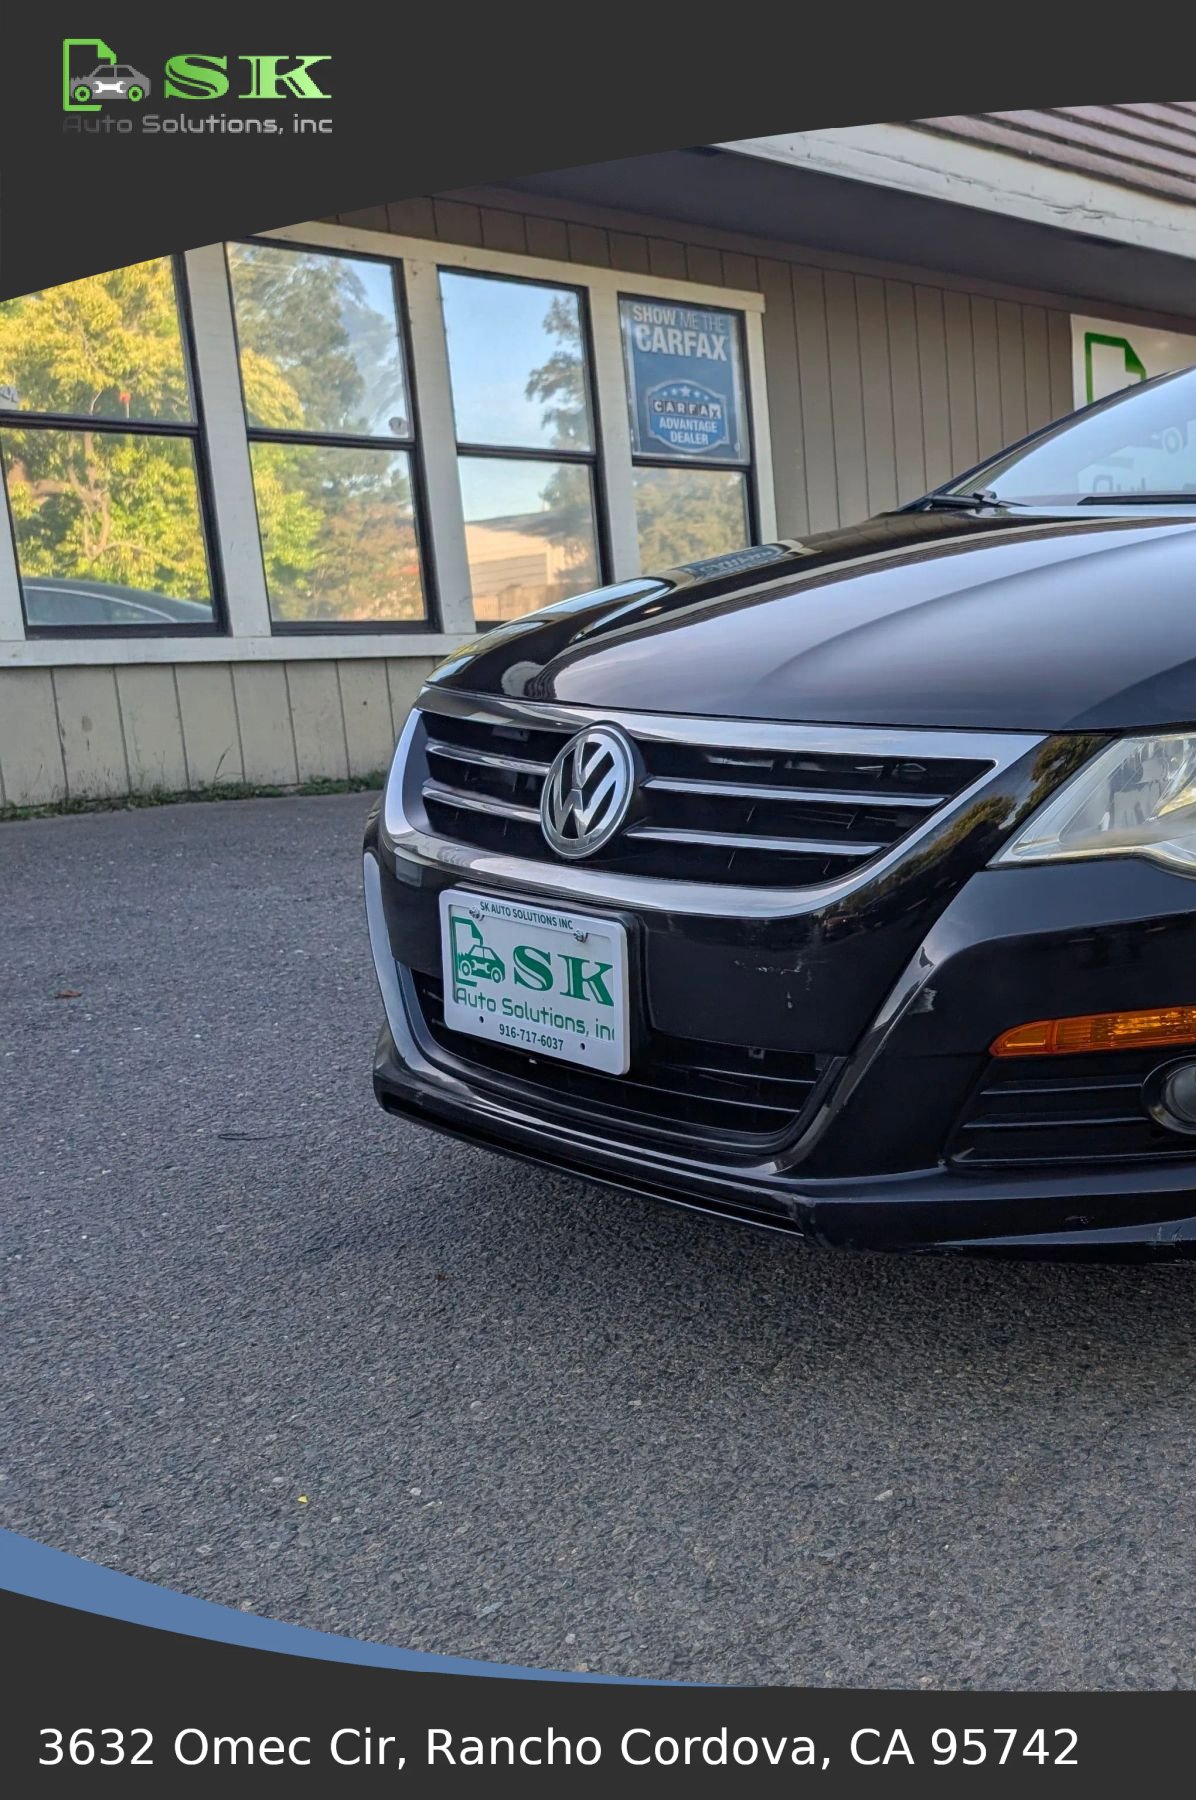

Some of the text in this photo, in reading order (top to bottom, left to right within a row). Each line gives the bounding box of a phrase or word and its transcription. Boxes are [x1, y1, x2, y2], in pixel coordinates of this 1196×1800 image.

[633, 305, 725, 332] SHOW ME THE
[635, 324, 728, 362] CARFAX
[653, 400, 721, 419] CARFAX
[659, 417, 718, 433] ADVANTAGE
[670, 431, 709, 446] DEALER
[479, 901, 574, 931] SK AUTO SOLUTIONS INC
[513, 945, 615, 1007] SK
[456, 987, 497, 1012] Auto
[502, 997, 590, 1038] Solutions,
[499, 1023, 565, 1052] 916-717-6037
